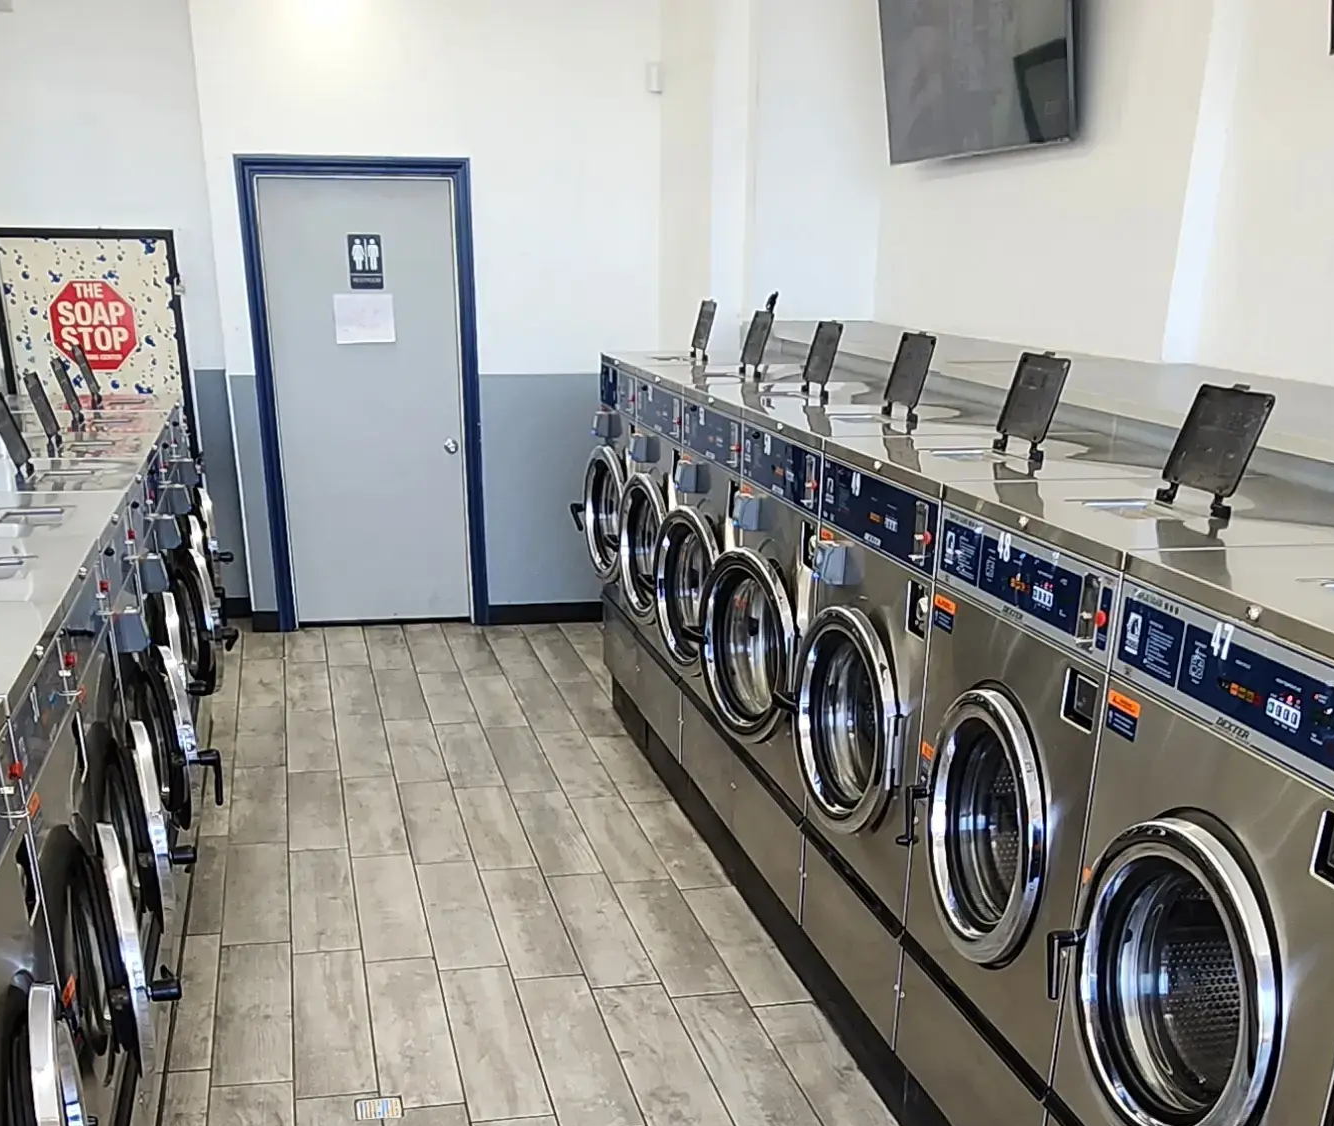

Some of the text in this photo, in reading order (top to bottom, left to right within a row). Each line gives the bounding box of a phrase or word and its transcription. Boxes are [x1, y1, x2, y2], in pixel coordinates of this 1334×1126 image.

[72, 283, 105, 298] THE
[57, 301, 126, 327] SOAP
[60, 326, 129, 351] STOP
[996, 531, 1012, 563] 48
[1210, 621, 1235, 661] 47
[1216, 716, 1250, 740] DEXTER
